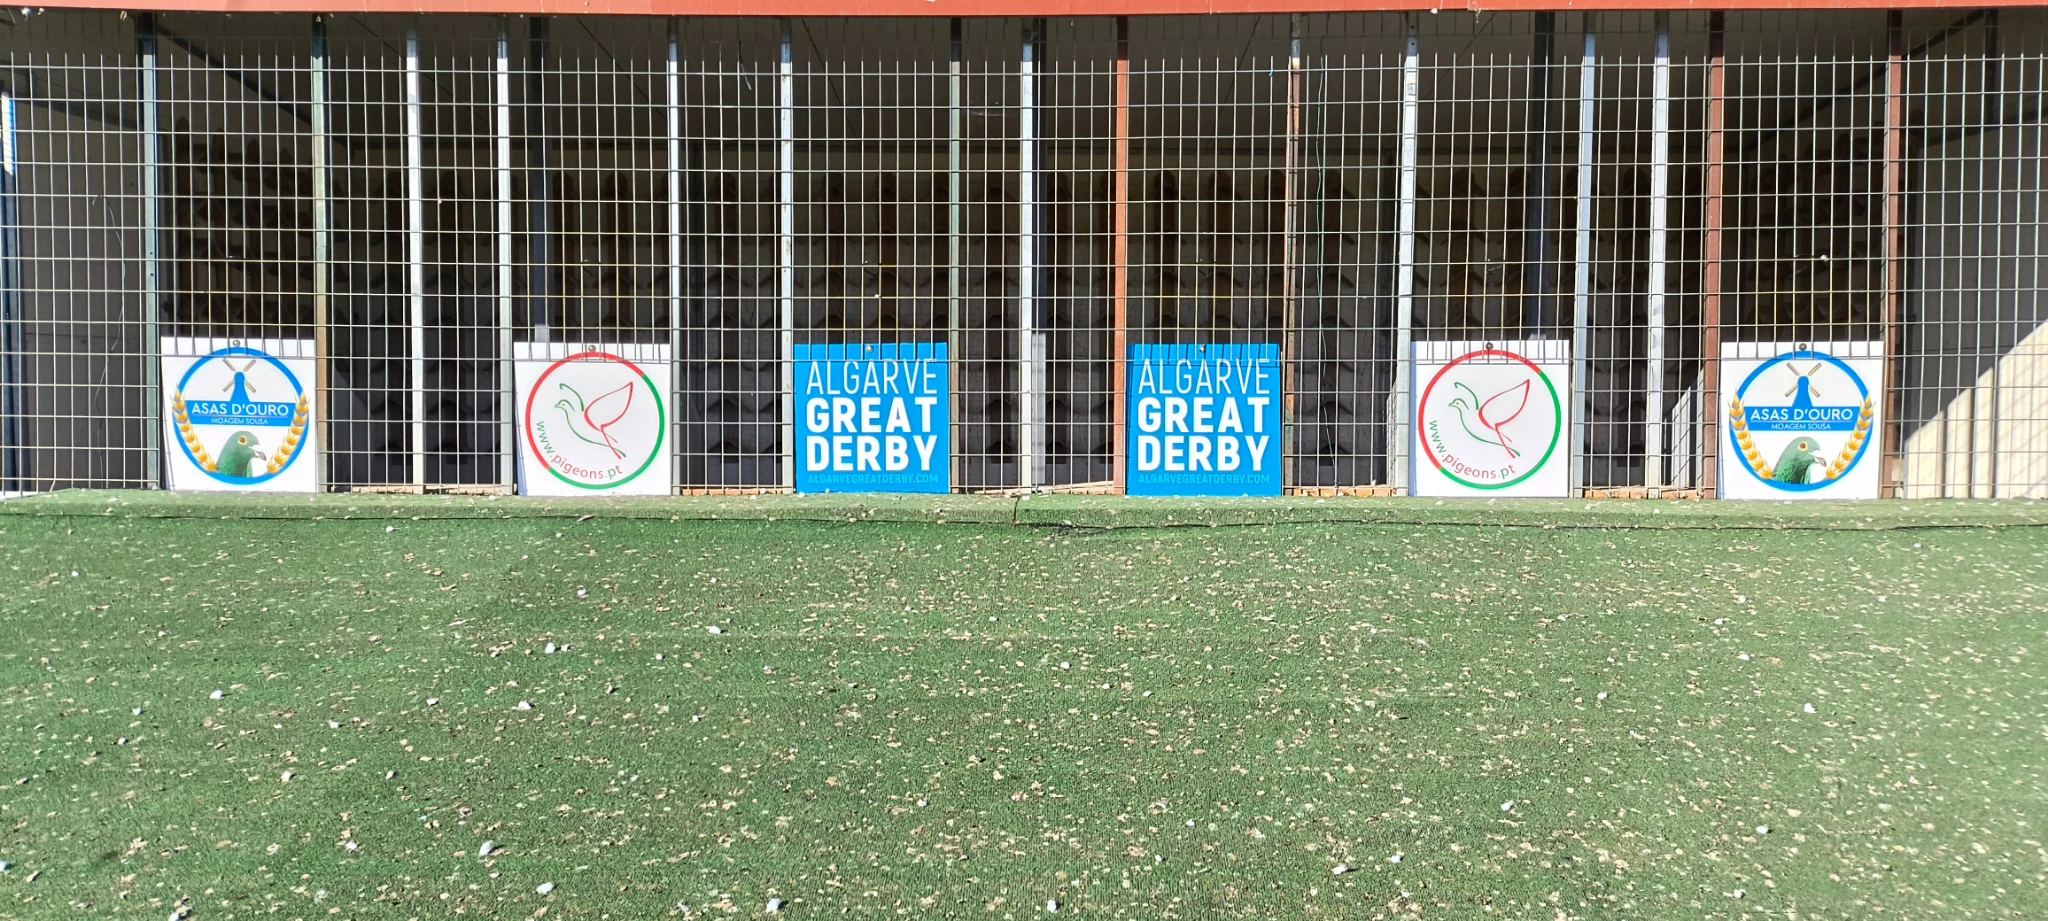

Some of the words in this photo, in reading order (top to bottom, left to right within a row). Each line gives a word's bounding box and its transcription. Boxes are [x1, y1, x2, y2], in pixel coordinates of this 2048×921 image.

[806, 358, 938, 395] ALGARVE
[1138, 358, 1270, 395] ALGARVE
[191, 402, 227, 415] ASAS
[231, 403, 289, 416] D'OURO
[211, 417, 245, 425] MOAGEM
[806, 396, 938, 433] GREAT
[1137, 396, 1270, 433] GREAT
[1750, 408, 1789, 420] ASAS
[1793, 408, 1853, 421] D'OURO
[536, 420, 623, 480] www.pigeons.pt
[806, 435, 938, 472] DERBY
[1137, 435, 1270, 472] DERBY
[1429, 419, 1516, 480] www.pigeons.pt
[807, 473, 939, 484] ALGARVEGREATDERBY.COM
[1138, 473, 1270, 484] ALGARVEGREATDERBY.COM
